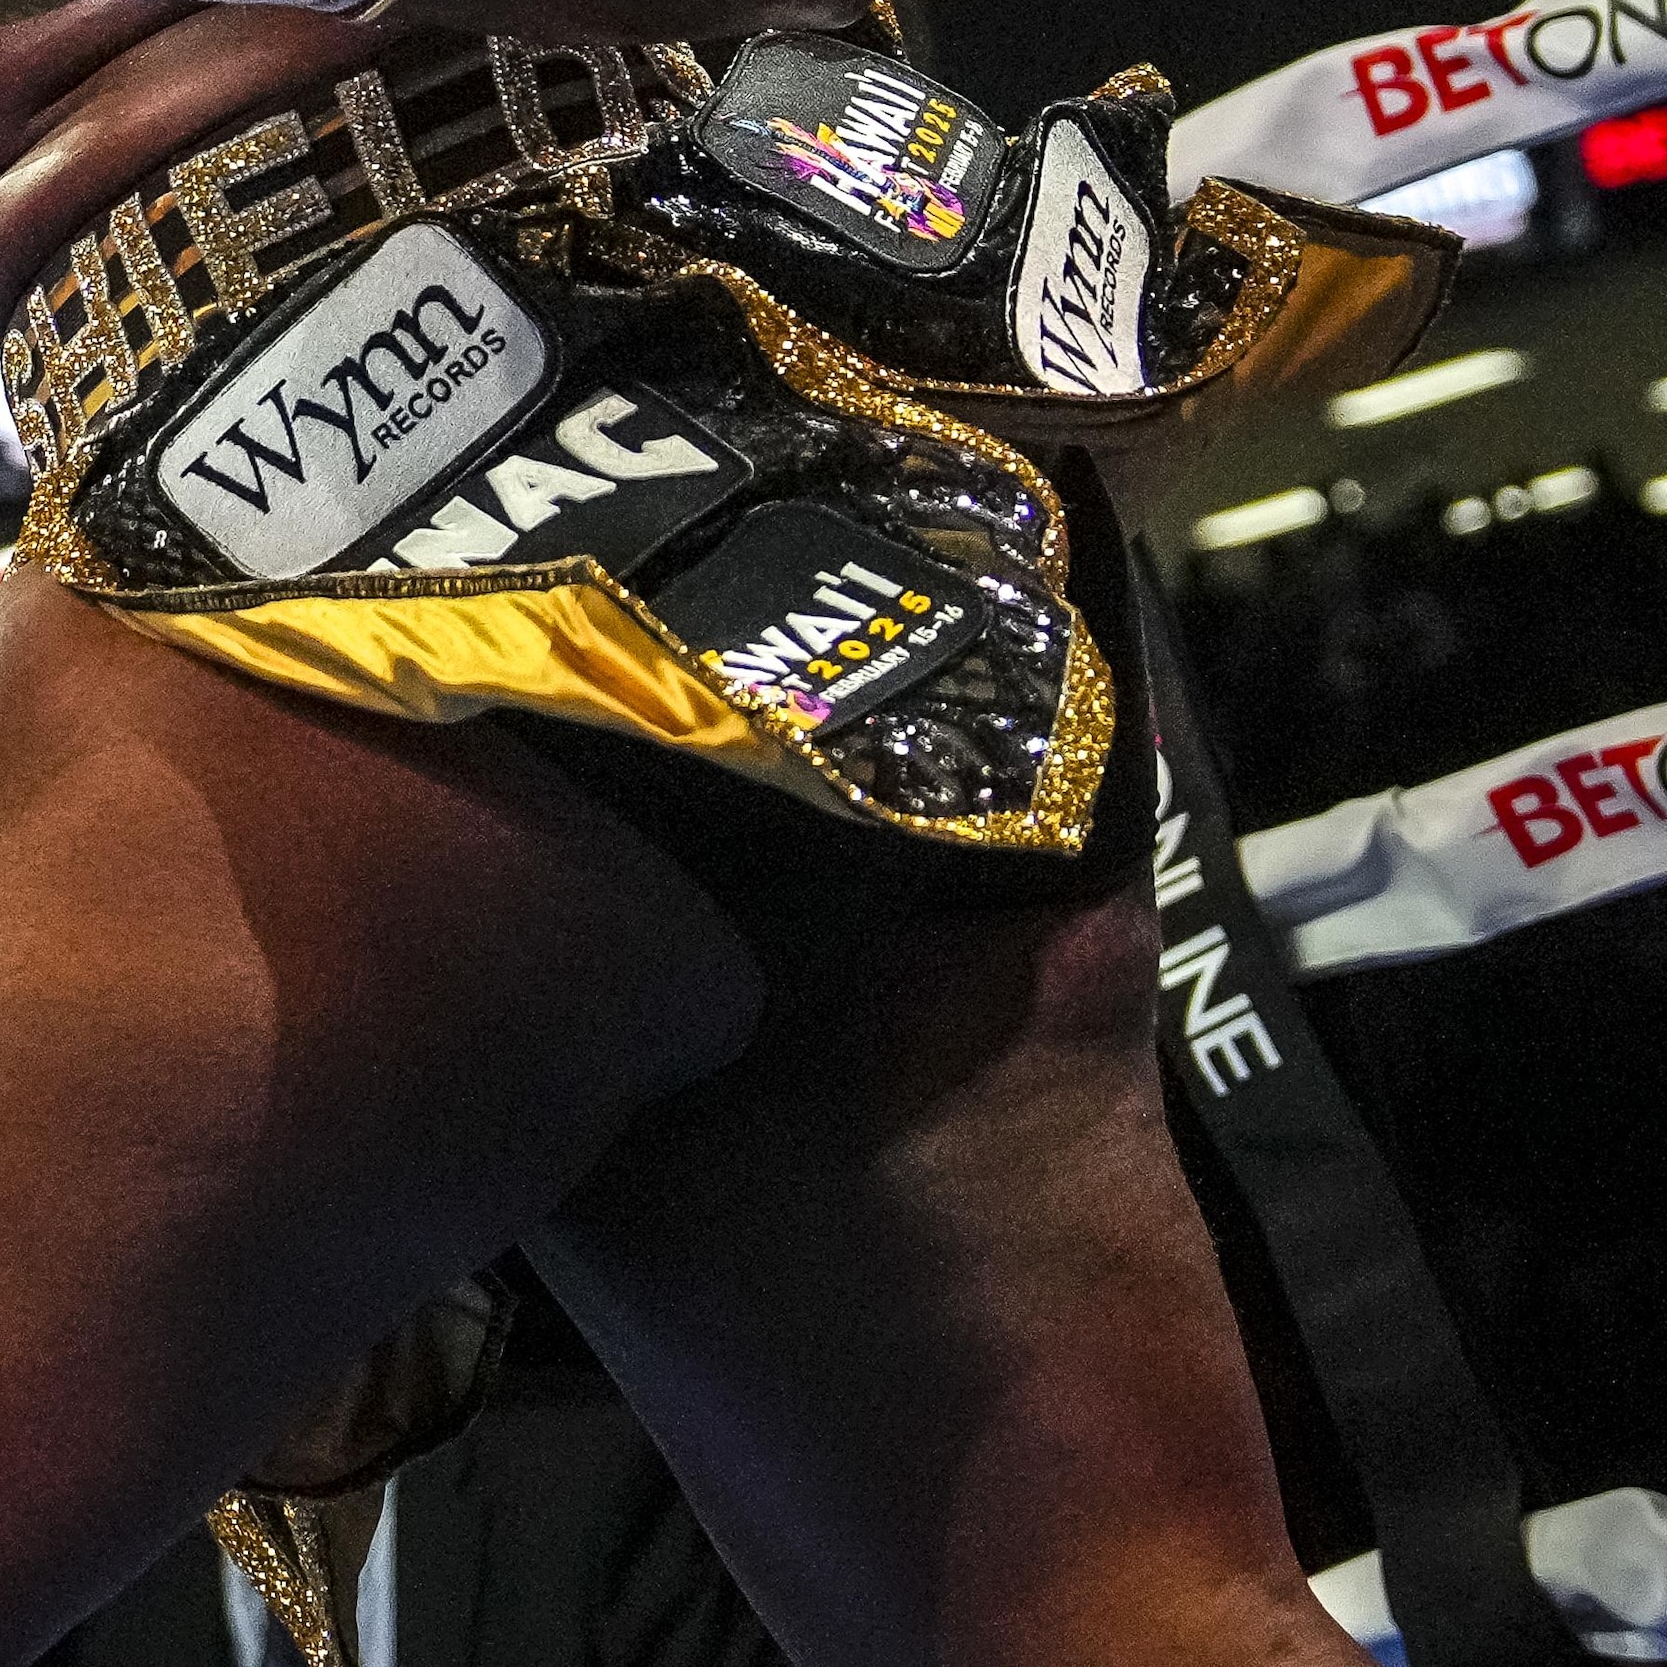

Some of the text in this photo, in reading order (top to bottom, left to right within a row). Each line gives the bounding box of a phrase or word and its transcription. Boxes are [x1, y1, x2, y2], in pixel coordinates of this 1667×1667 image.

[907, 98, 957, 165] 2025
[939, 139, 974, 194] FEBRUARY
[1039, 180, 1119, 394] Wynn
[1099, 219, 1127, 336] RECORDS
[180, 283, 485, 517] Wynn
[372, 327, 508, 451] RECORDS
[367, 393, 720, 571] NAC
[806, 589, 932, 680] 2025
[818, 603, 965, 704] FEBRUARY 15-16
[1487, 735, 1667, 869] BET
